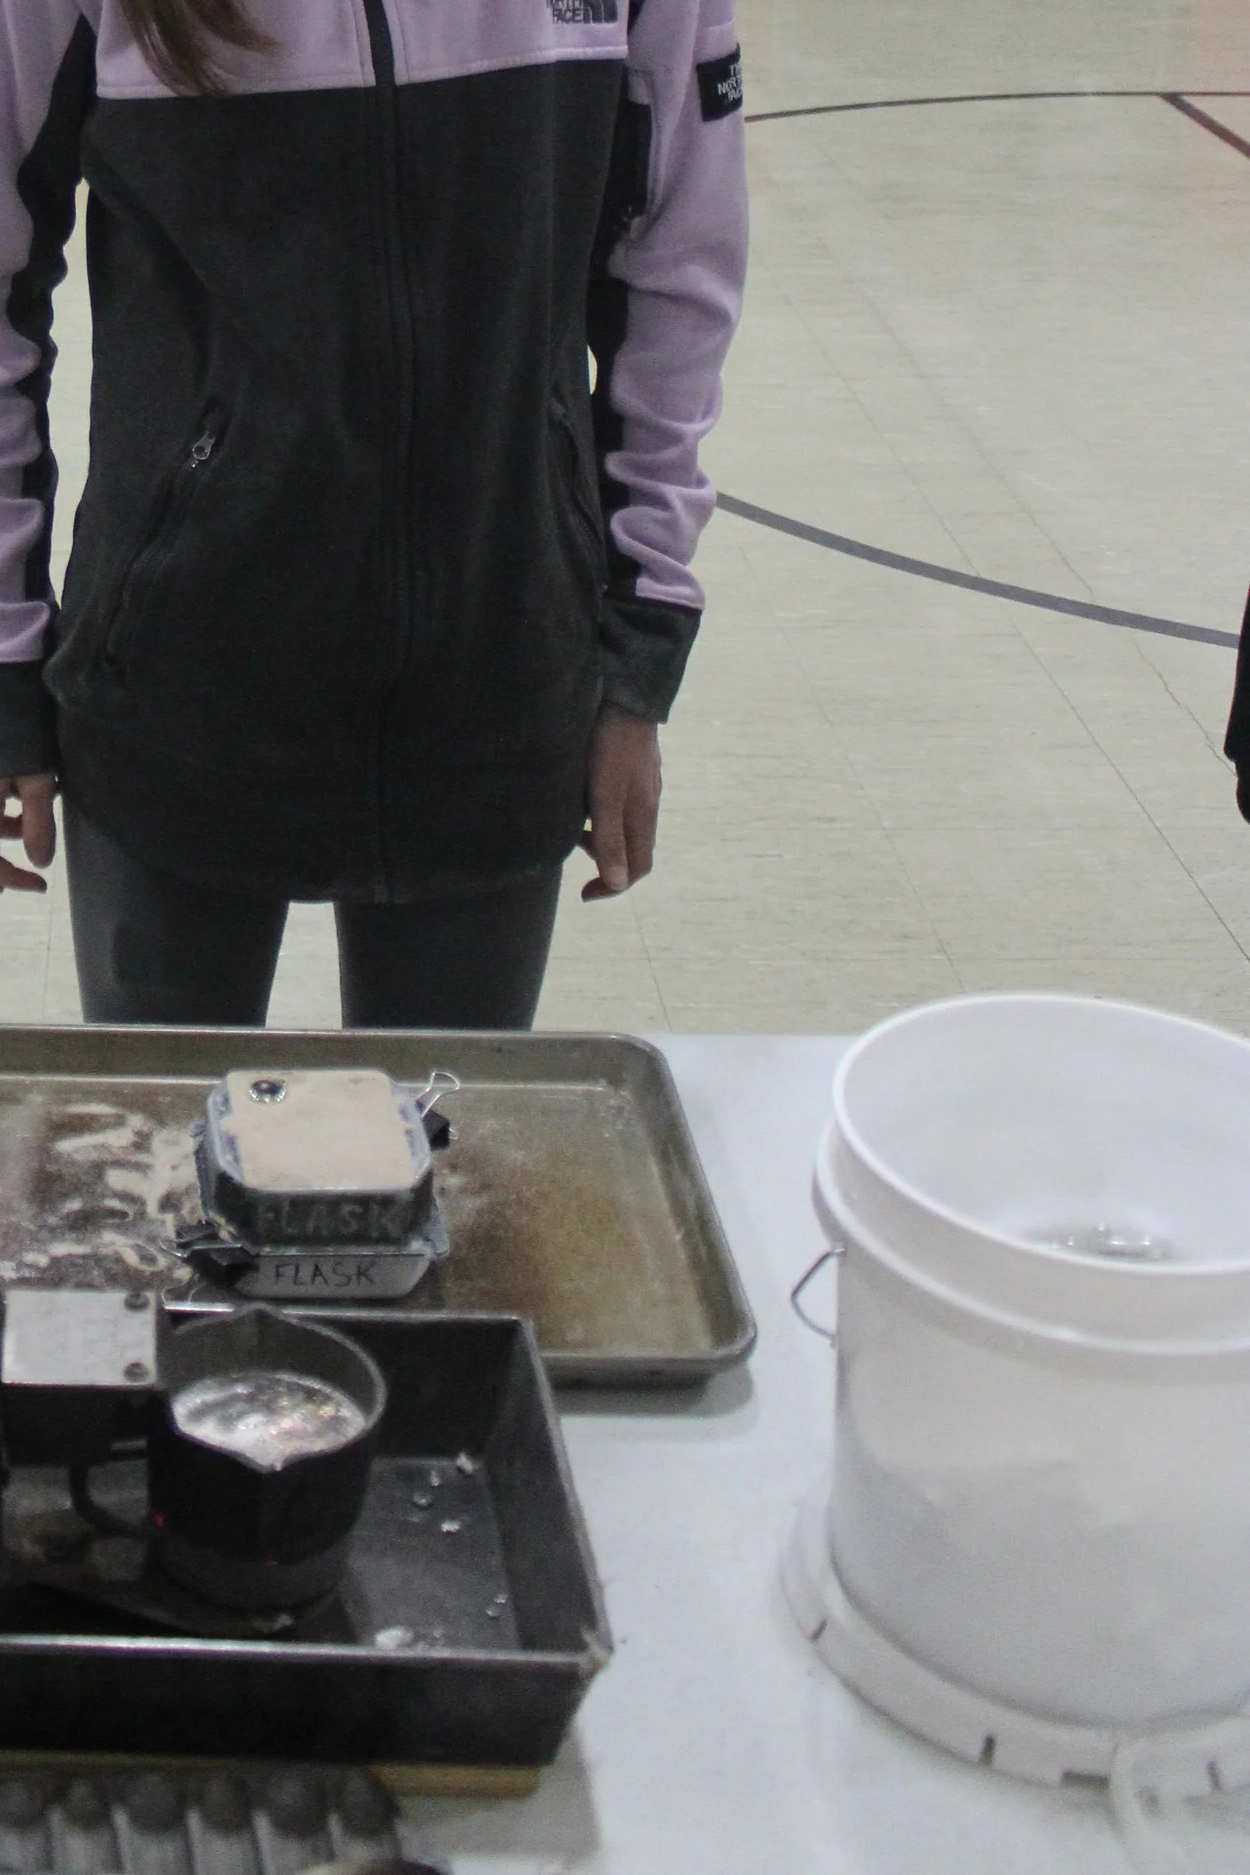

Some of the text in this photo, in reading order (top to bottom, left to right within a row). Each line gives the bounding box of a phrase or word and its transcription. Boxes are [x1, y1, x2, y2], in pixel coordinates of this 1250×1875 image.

[551, 9, 584, 25] FACE
[257, 1199, 403, 1238] FLASK
[273, 1262, 377, 1288] FLASK
